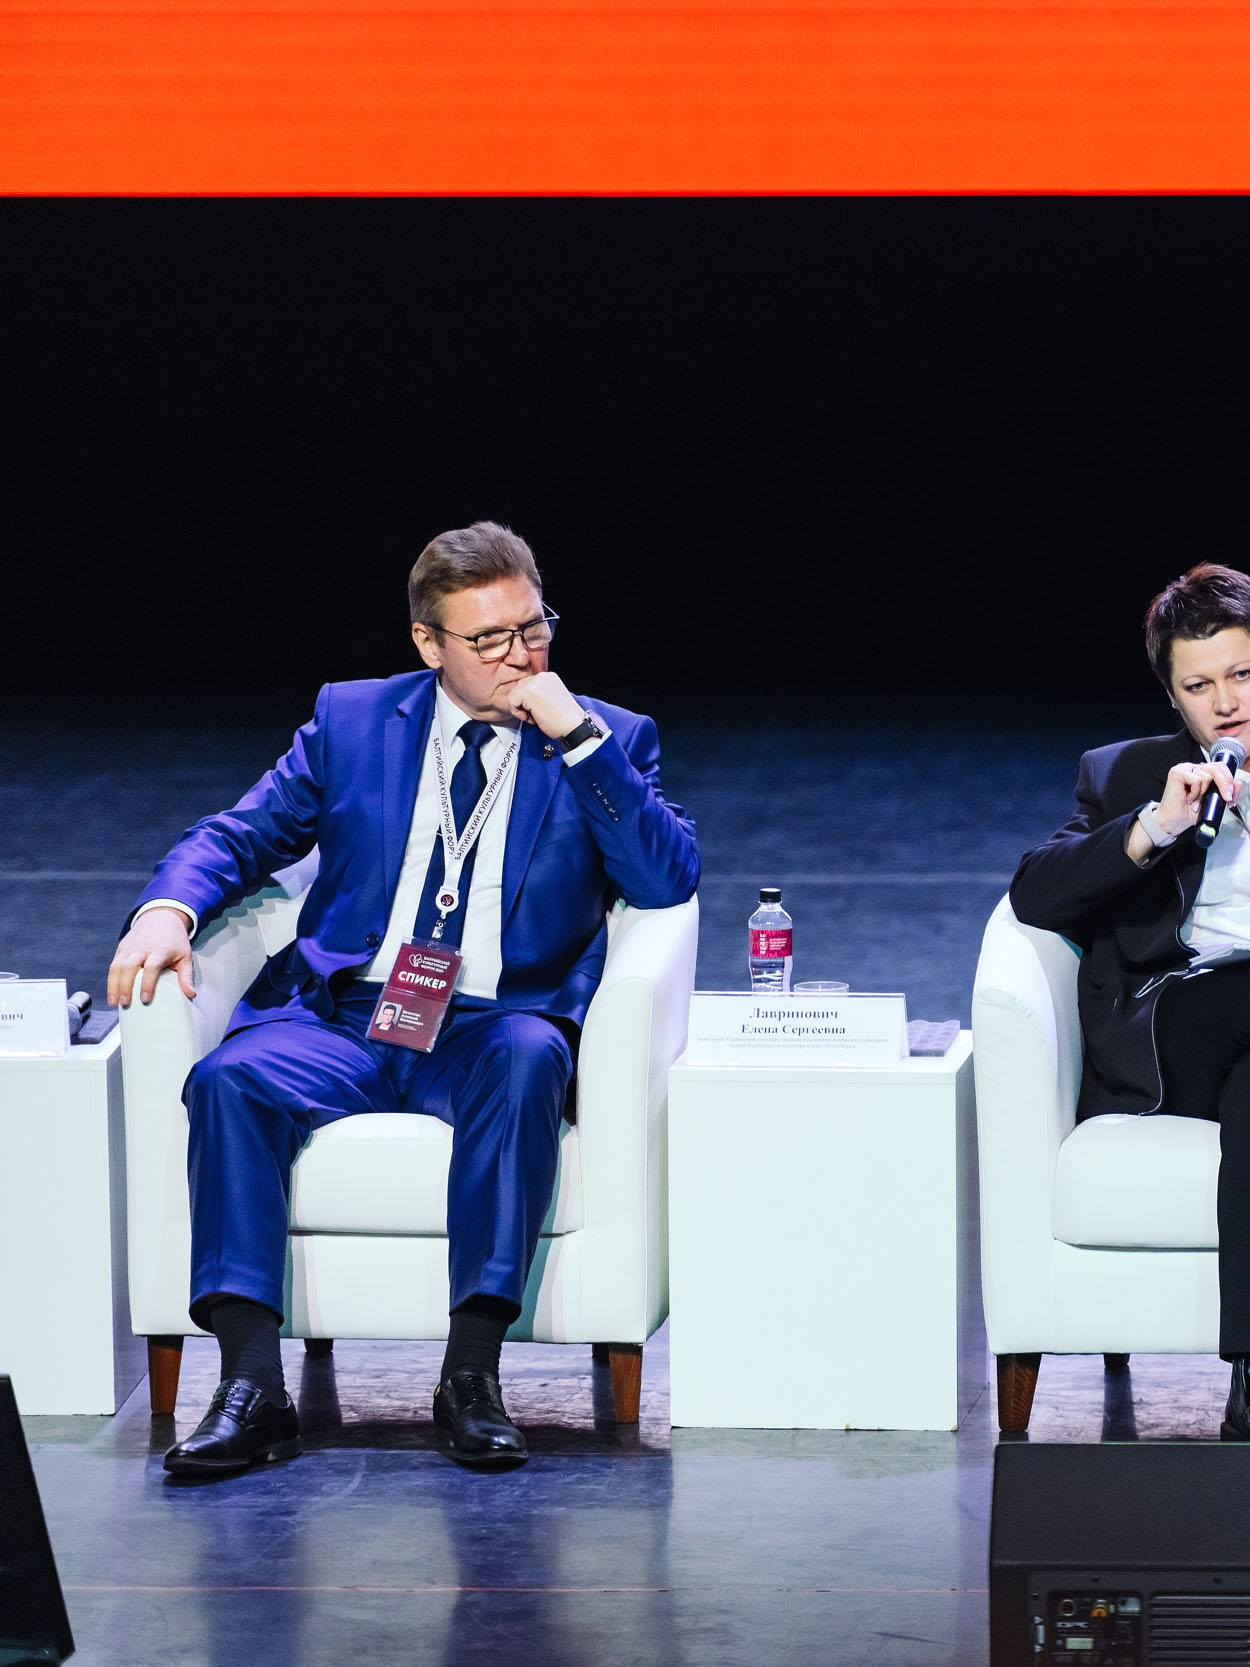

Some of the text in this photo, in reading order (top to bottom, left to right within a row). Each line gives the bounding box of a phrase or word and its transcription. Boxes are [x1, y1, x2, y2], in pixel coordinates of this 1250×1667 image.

[433, 737, 446, 786] БАЛТИЙСКИЙ
[440, 787, 454, 834] КУЛЬТУРНЫЙ
[454, 742, 517, 860] БАЛТИЙСКИЙ КУЛЬТУРНЫЙ ФОРУМ
[398, 970, 447, 990] СПИКЕР
[749, 1007, 838, 1021] Лавринович
[741, 1024, 846, 1036] Елена Сергеевна
